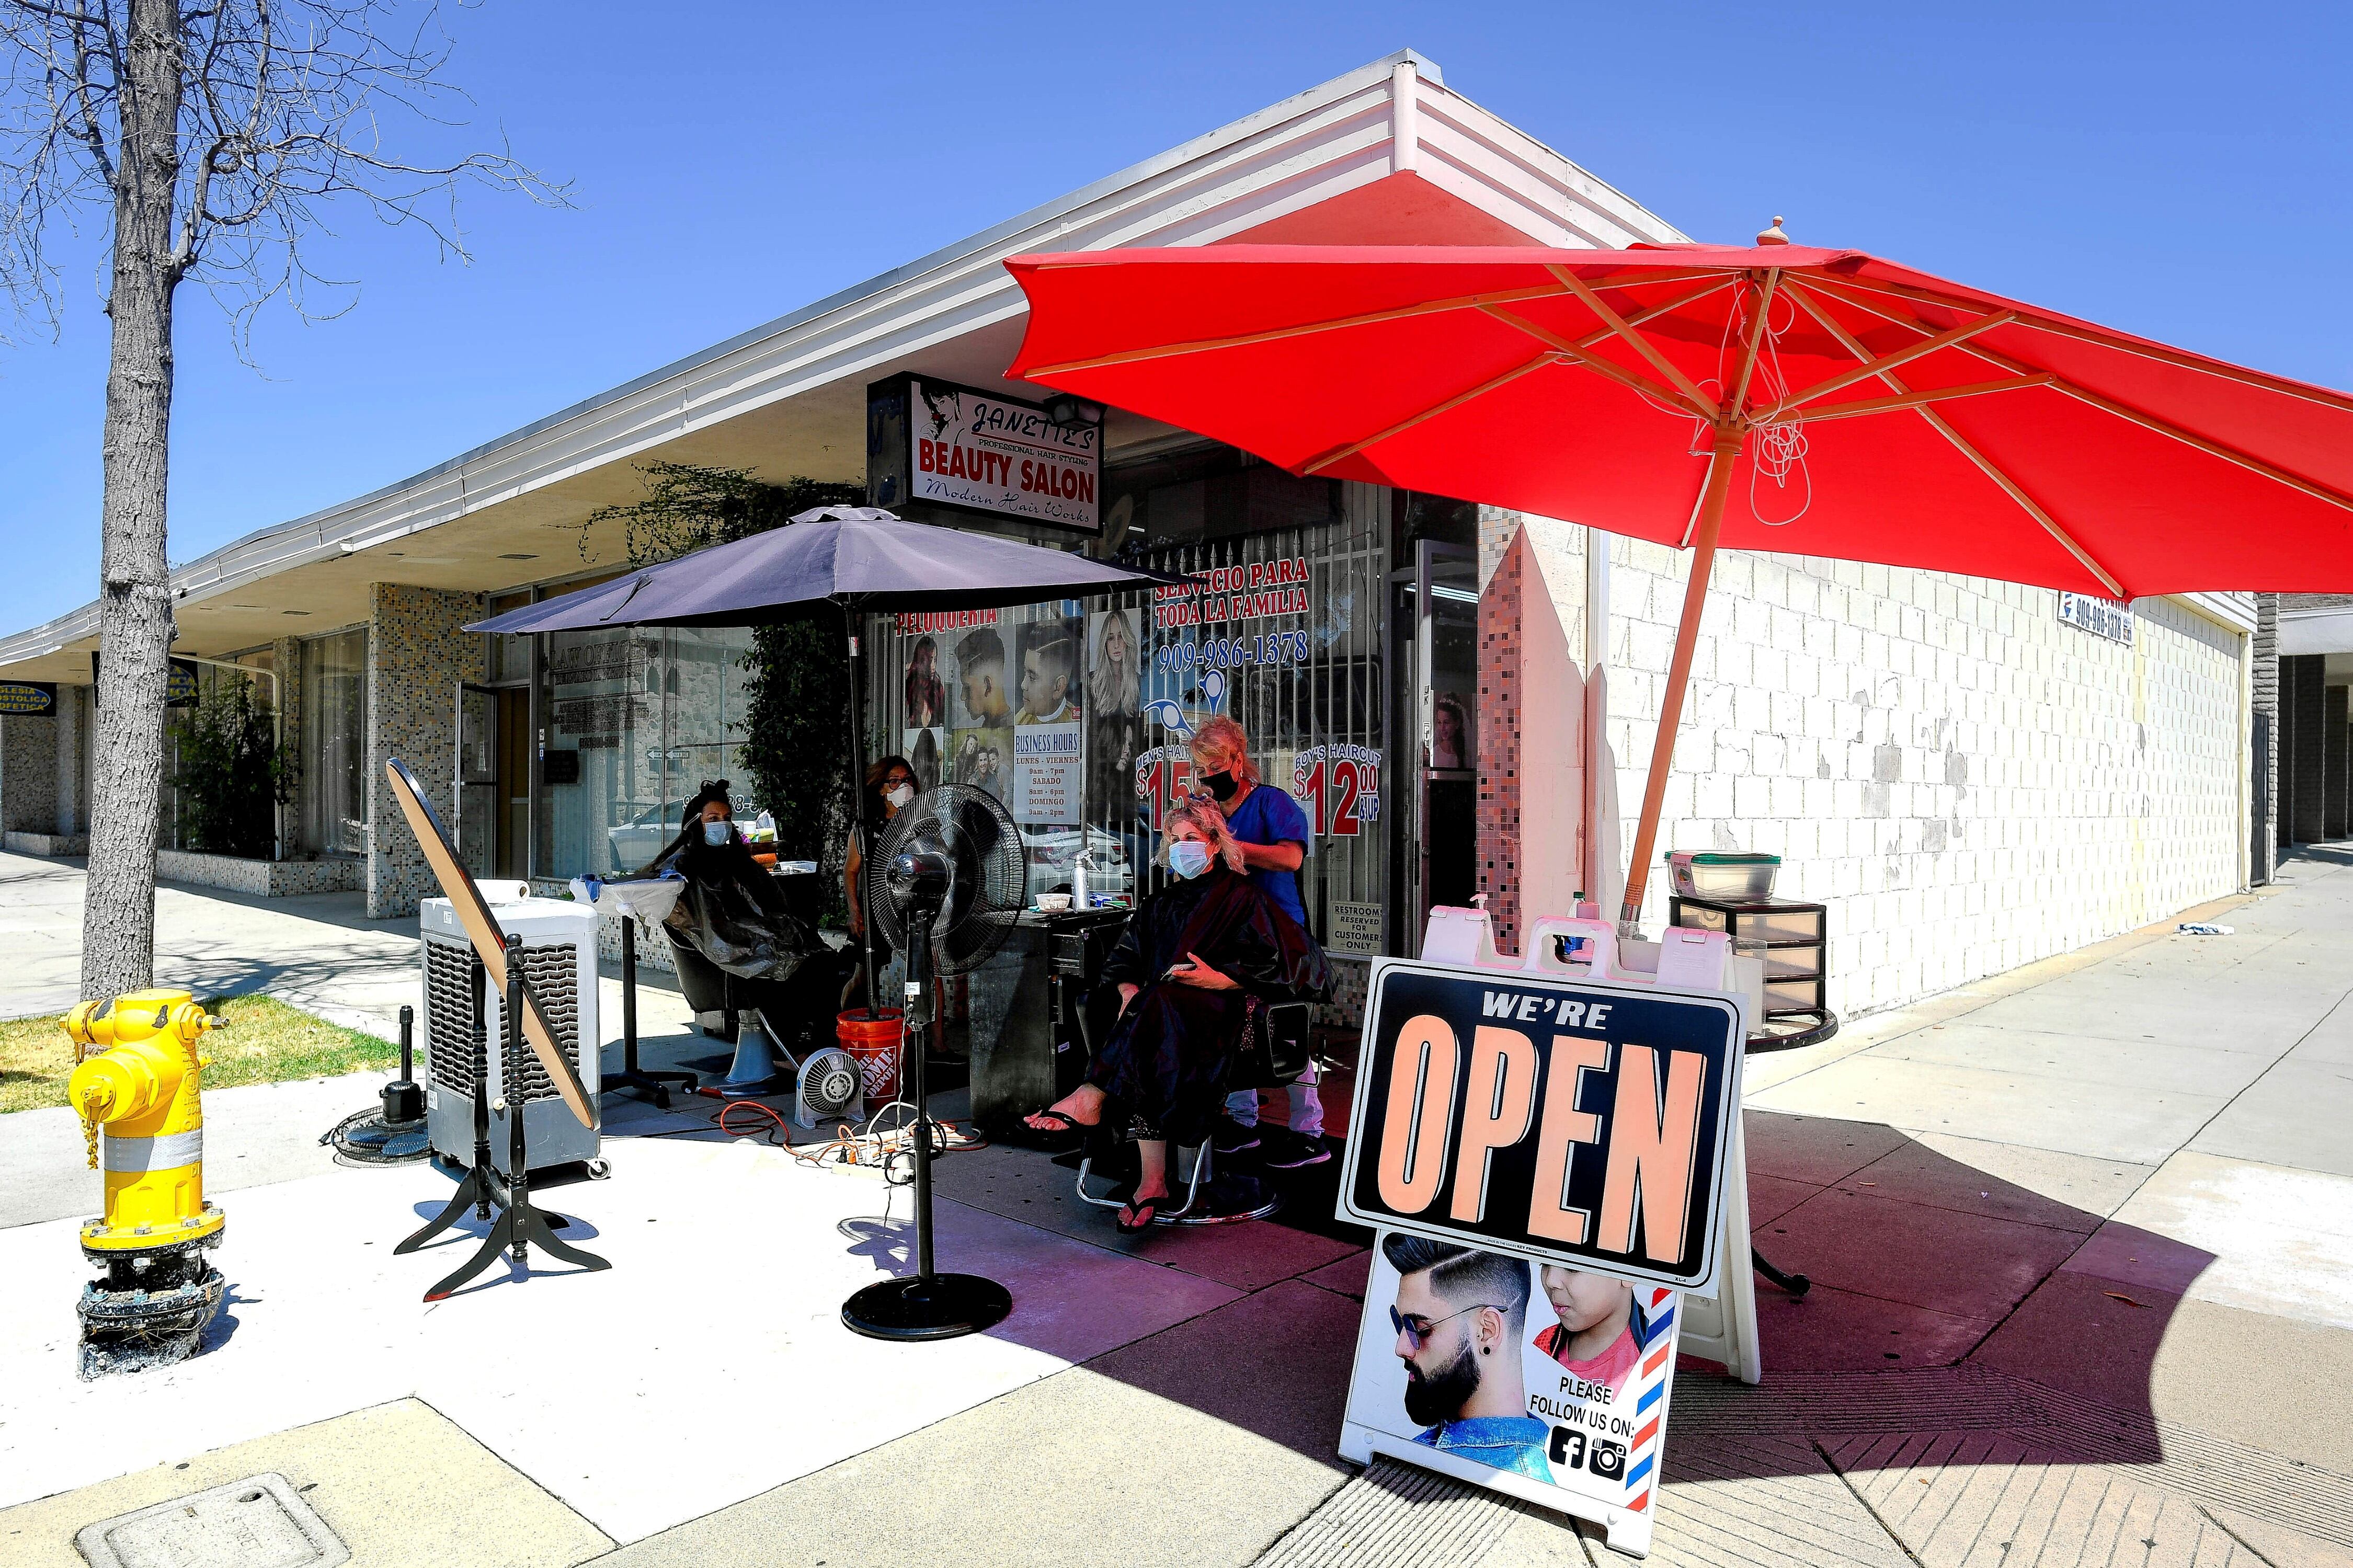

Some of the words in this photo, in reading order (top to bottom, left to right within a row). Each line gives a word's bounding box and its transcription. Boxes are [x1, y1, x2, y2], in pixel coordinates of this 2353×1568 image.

[978, 438, 1034, 456] PROFESSIONAL
[1037, 450, 1056, 460] HAIR
[1058, 454, 1089, 466] STYLING
[919, 438, 1013, 487] BEAUTY
[1020, 459, 1094, 505] SALON
[926, 478, 993, 505] Modern
[997, 493, 1040, 514] Hair
[1044, 501, 1090, 523] Works
[1249, 557, 1309, 588] PARA
[1156, 601, 1201, 629] TODA
[1204, 598, 1228, 623] LA
[1231, 588, 1309, 621] FAMILIA
[2076, 598, 2121, 640] 909-986-1378
[551, 647, 581, 670] LAW
[584, 637, 647, 666] OFFICES
[1159, 630, 1307, 674] 909-986-1378
[1015, 734, 1050, 752] BUSINESS
[1053, 733, 1078, 751] HOURS
[1136, 746, 1163, 770] MEN'S
[1295, 745, 1326, 769] BOY'S
[1329, 743, 1381, 768] HAIRCUT
[1360, 797, 1366, 822] &
[1367, 797, 1379, 821] UP
[1340, 916, 1379, 925] RESERVED
[1346, 941, 1371, 949] ONLY
[1482, 991, 1613, 1030] WE'RE
[867, 1065, 895, 1096] DEPOT
[1377, 1014, 1707, 1265] OPEN
[1560, 1376, 1612, 1405] PLEASE
[1530, 1394, 1586, 1424] FOLLOW
[1590, 1411, 1606, 1430] US
[1611, 1417, 1635, 1439] ON:
